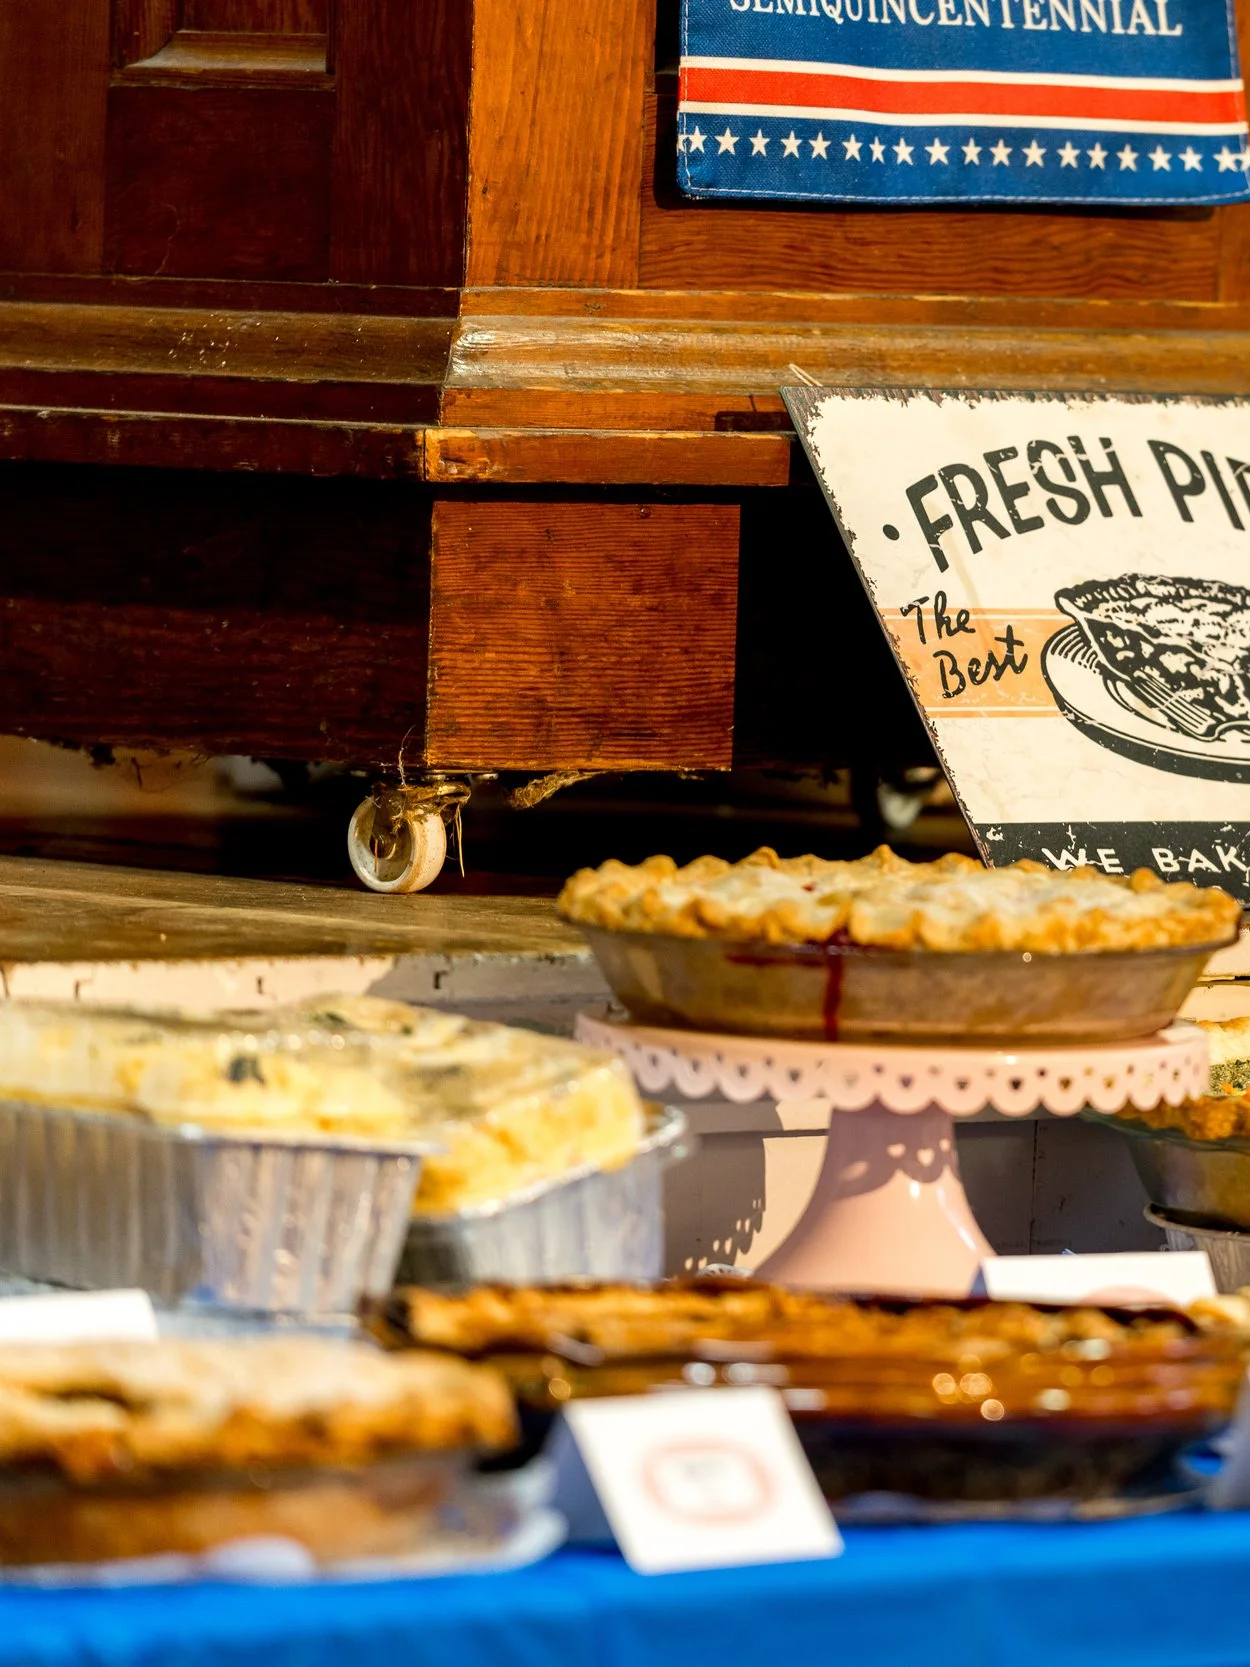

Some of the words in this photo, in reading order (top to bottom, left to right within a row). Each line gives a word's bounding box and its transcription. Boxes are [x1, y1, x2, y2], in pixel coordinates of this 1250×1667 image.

[905, 435, 1143, 573] FRESH
[900, 590, 976, 644] The
[933, 624, 1029, 698] Best
[1041, 848, 1124, 873] WE
